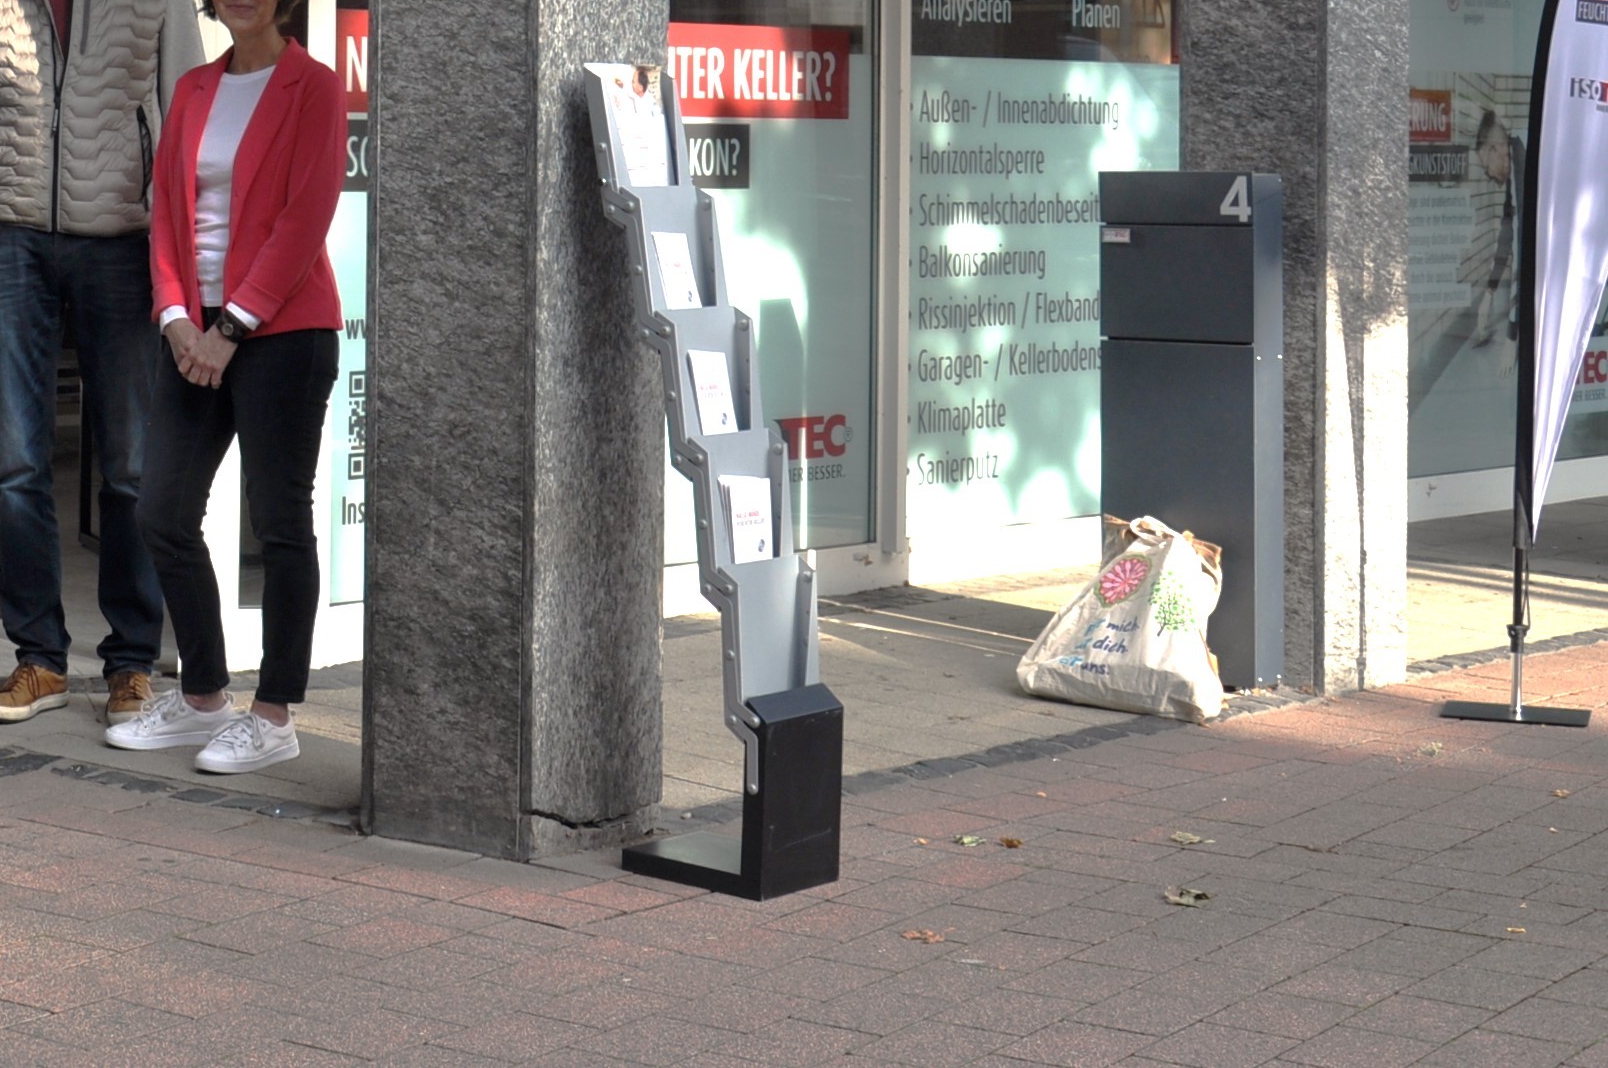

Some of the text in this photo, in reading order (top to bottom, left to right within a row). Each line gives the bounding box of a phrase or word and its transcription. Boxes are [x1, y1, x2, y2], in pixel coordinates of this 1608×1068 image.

[734, 48, 836, 102] KELLER?
[919, 90, 977, 123] Außen-
[997, 92, 1119, 130] Innenabdichtung
[919, 142, 1045, 180] Horizontalsperre
[1219, 175, 1252, 223] 4
[919, 244, 1047, 280] Balkonsanierung
[918, 294, 1016, 334] Rissinjektion
[918, 349, 989, 386] Garagen-
[917, 398, 1007, 436] Klimaplatte
[917, 451, 1000, 487] Sanierputz
